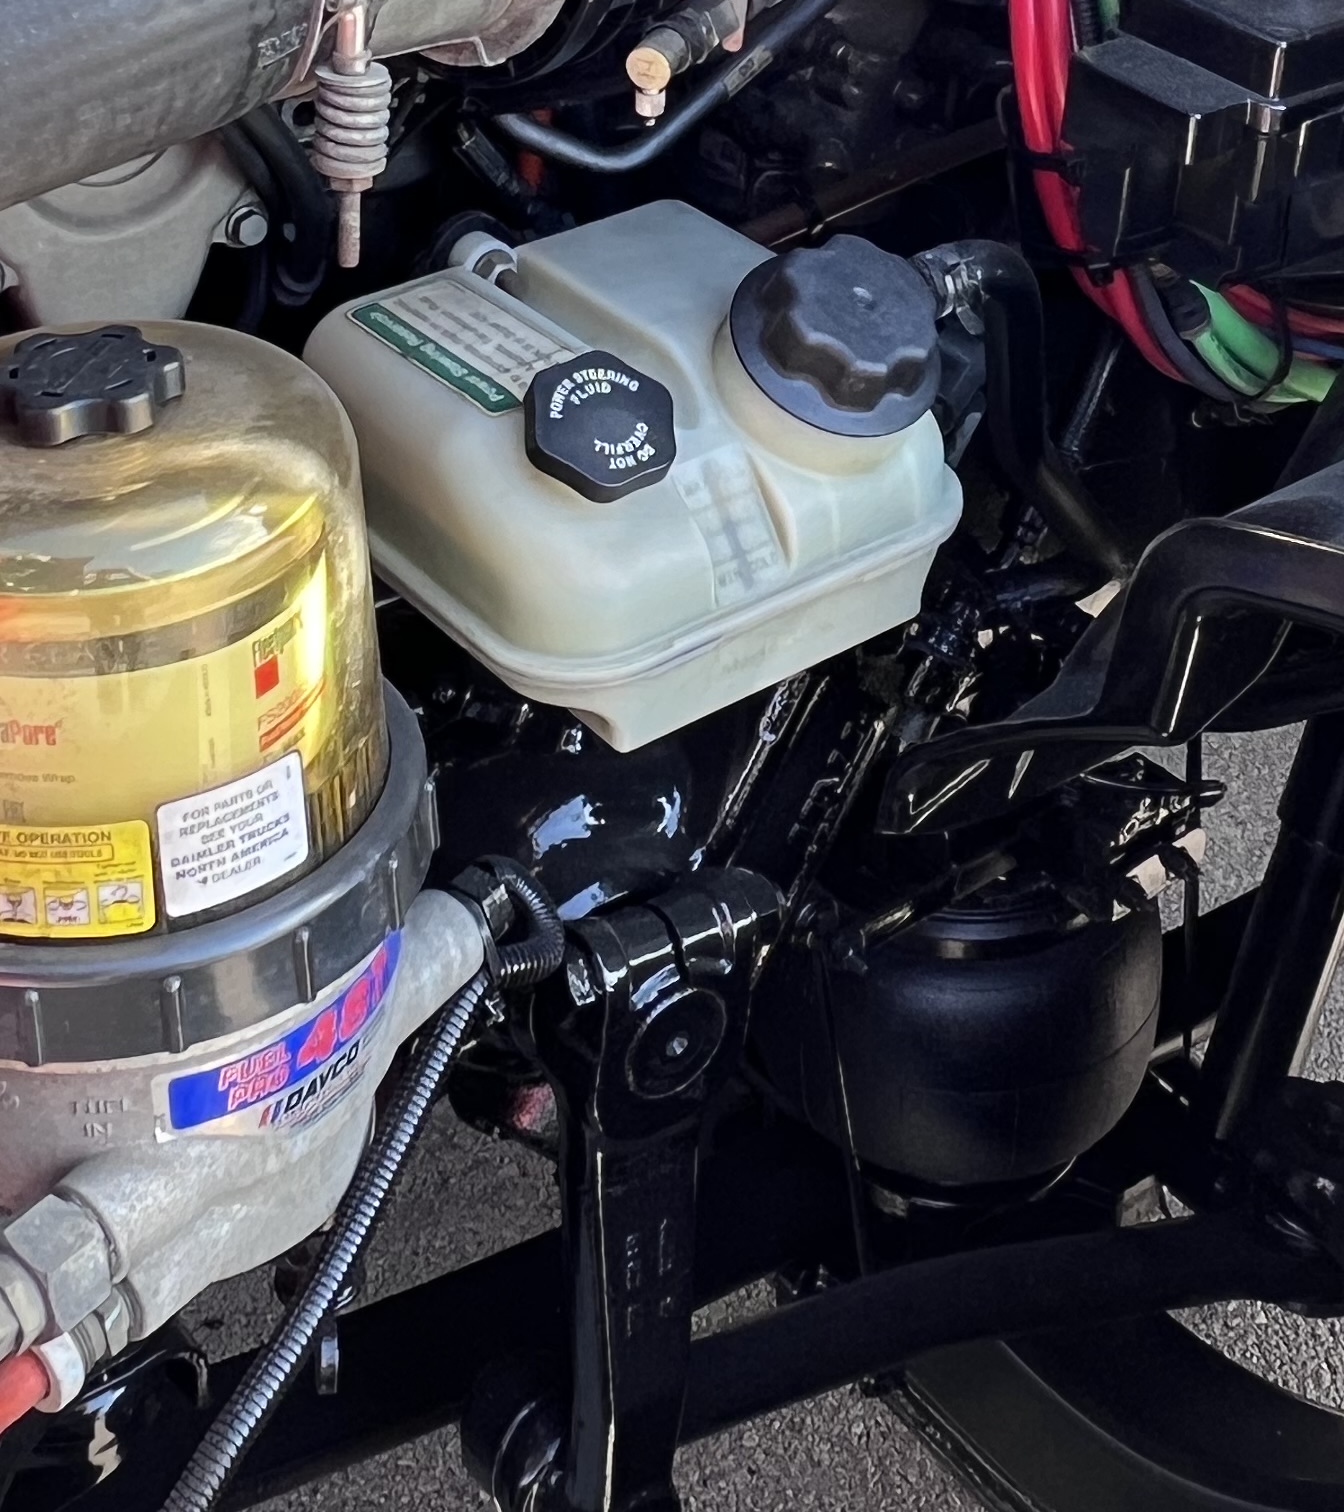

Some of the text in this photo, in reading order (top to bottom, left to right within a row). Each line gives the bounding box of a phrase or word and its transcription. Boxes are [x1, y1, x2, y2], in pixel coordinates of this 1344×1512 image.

[549, 368, 640, 419] POWER STEERING
[569, 381, 612, 405] FLUID
[593, 422, 649, 456] OVERFILL
[608, 454, 638, 470] NOT
[179, 790, 280, 838] REPLACEMENTS
[182, 779, 274, 823] FOR PARTS OR
[16, 830, 113, 846] OPERATION
[170, 813, 291, 868] DAIMLER TRUCKS
[201, 812, 264, 845] SEE YOUR
[175, 828, 290, 880] NORTH AMERICA
[212, 855, 262, 883] DEALER
[218, 1042, 292, 1091] FUEL
[227, 1064, 290, 1112] PRO
[282, 1038, 360, 1115] DAYCO
